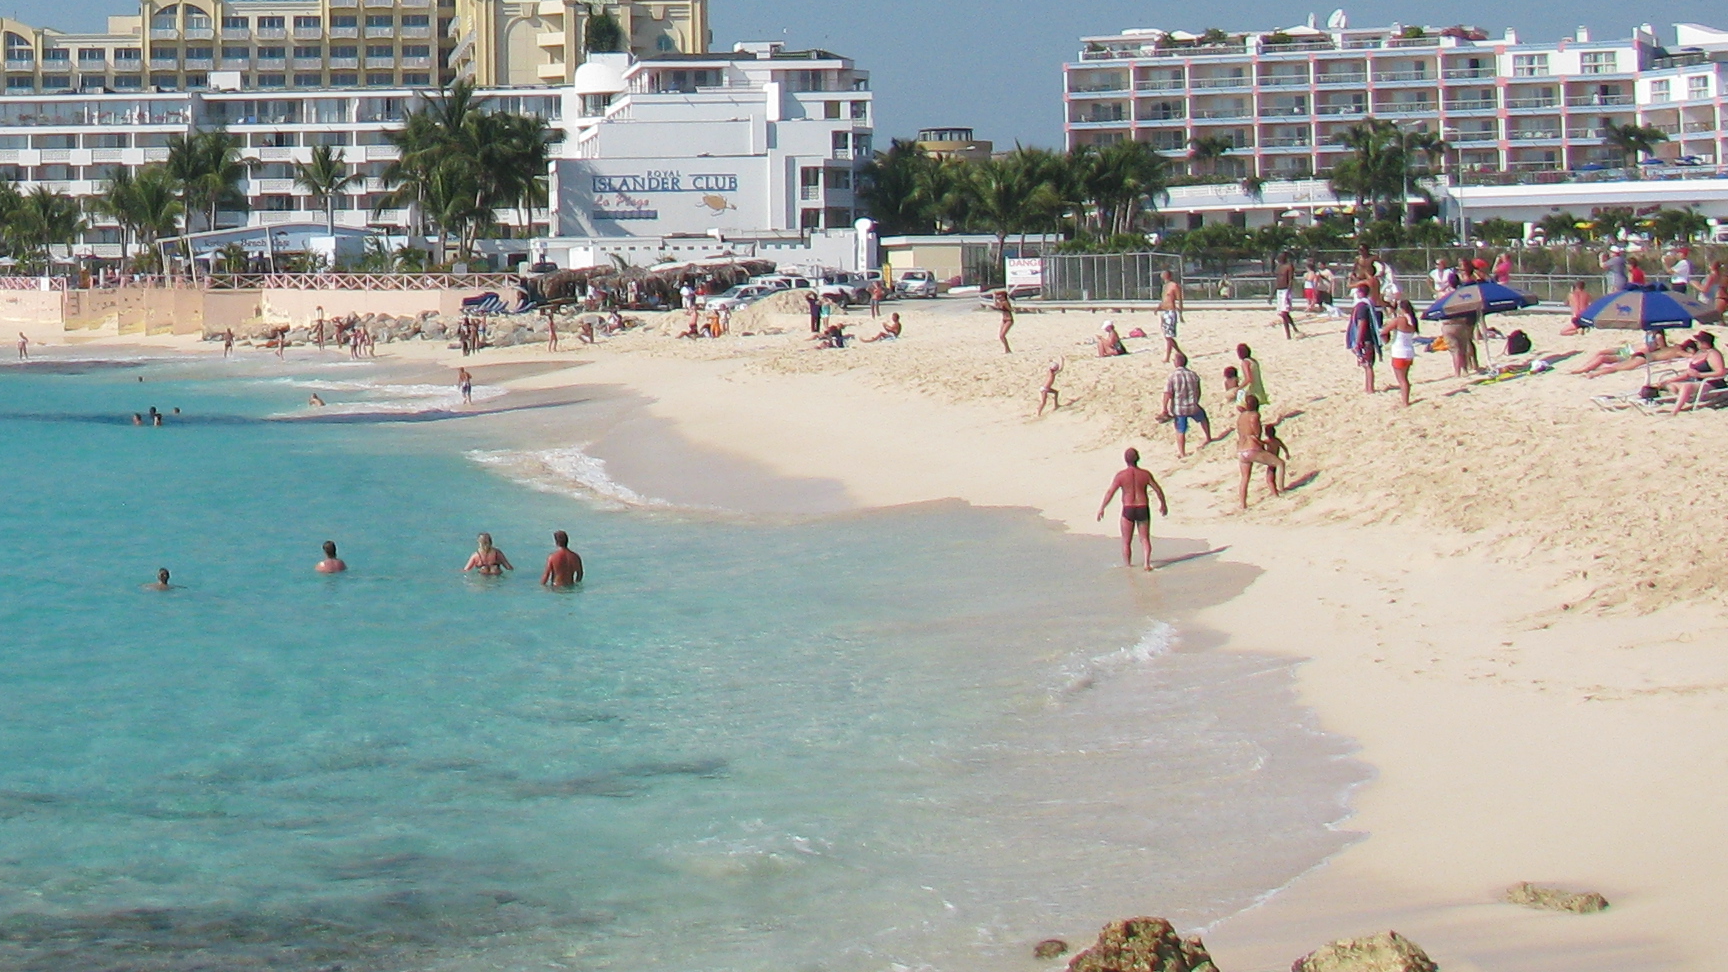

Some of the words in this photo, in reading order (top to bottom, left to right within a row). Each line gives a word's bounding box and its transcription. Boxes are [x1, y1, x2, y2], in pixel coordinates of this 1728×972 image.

[647, 170, 681, 178] ROYAL
[592, 177, 682, 192] ISLANDER
[692, 176, 738, 191] CLUB
